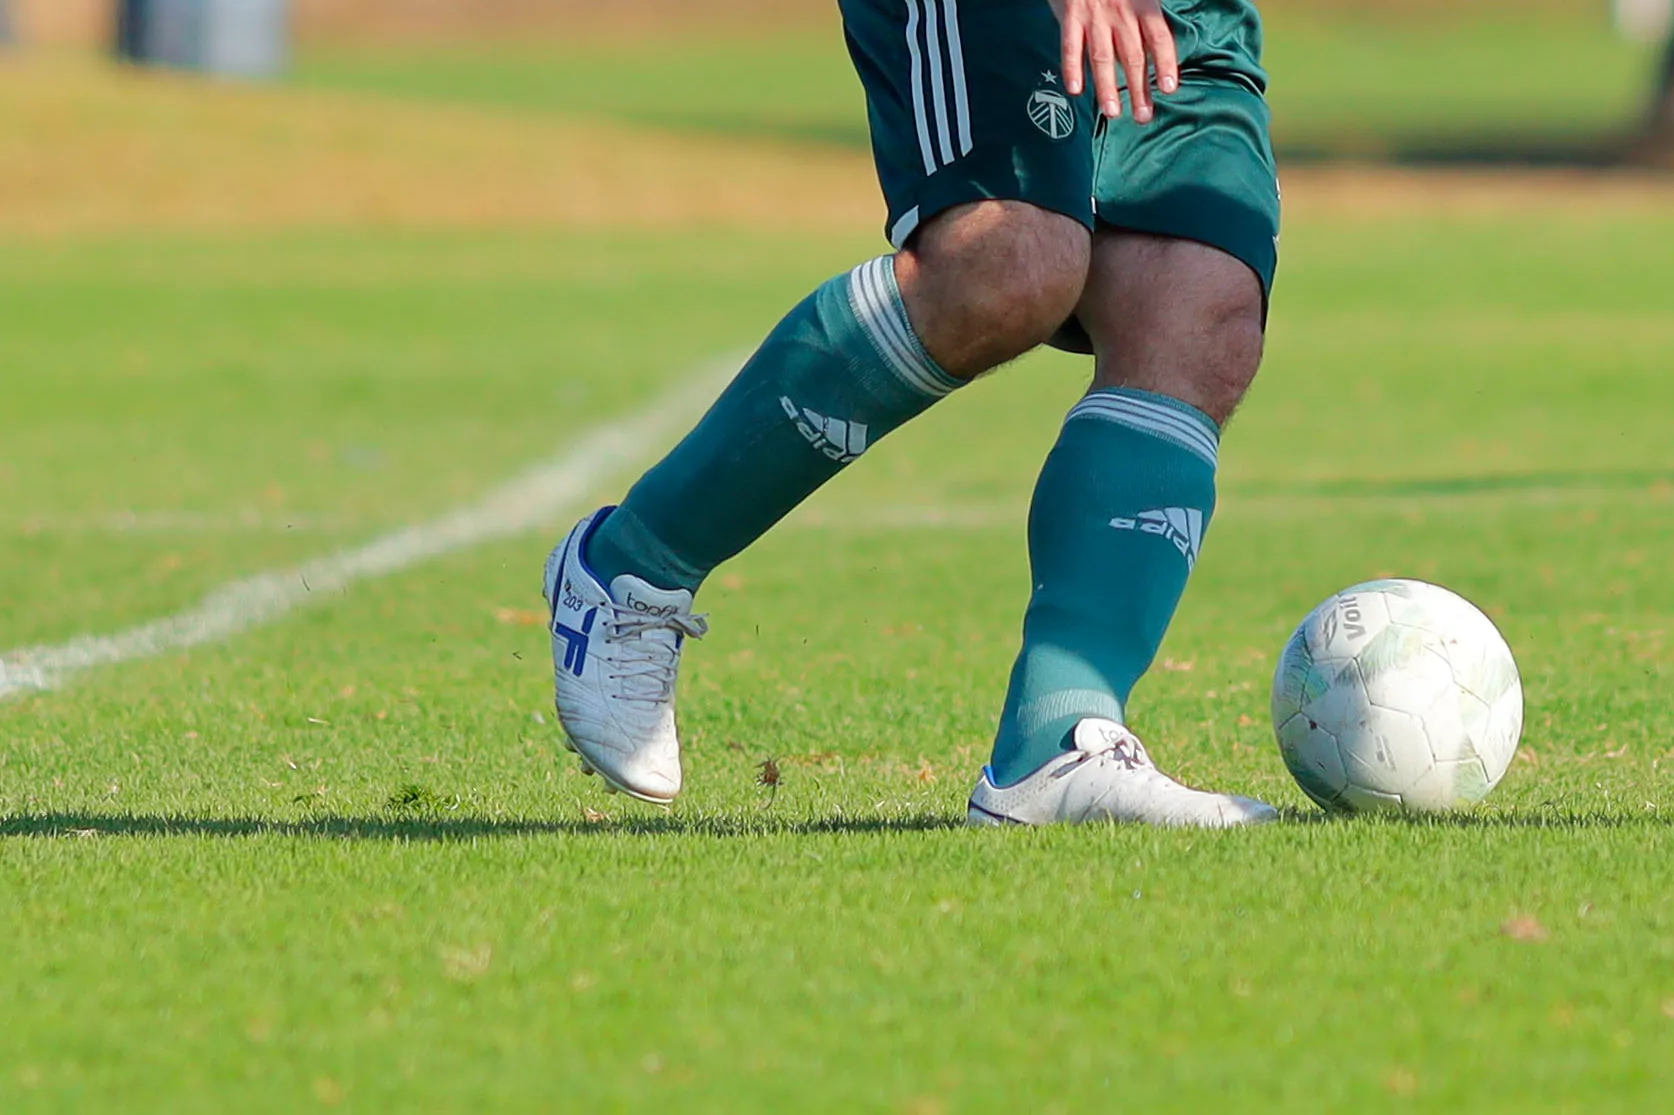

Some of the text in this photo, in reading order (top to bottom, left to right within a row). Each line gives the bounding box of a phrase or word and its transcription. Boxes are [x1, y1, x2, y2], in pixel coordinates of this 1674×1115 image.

[779, 395, 858, 464] adida
[1108, 517, 1194, 574] adida
[563, 591, 584, 612] 203
